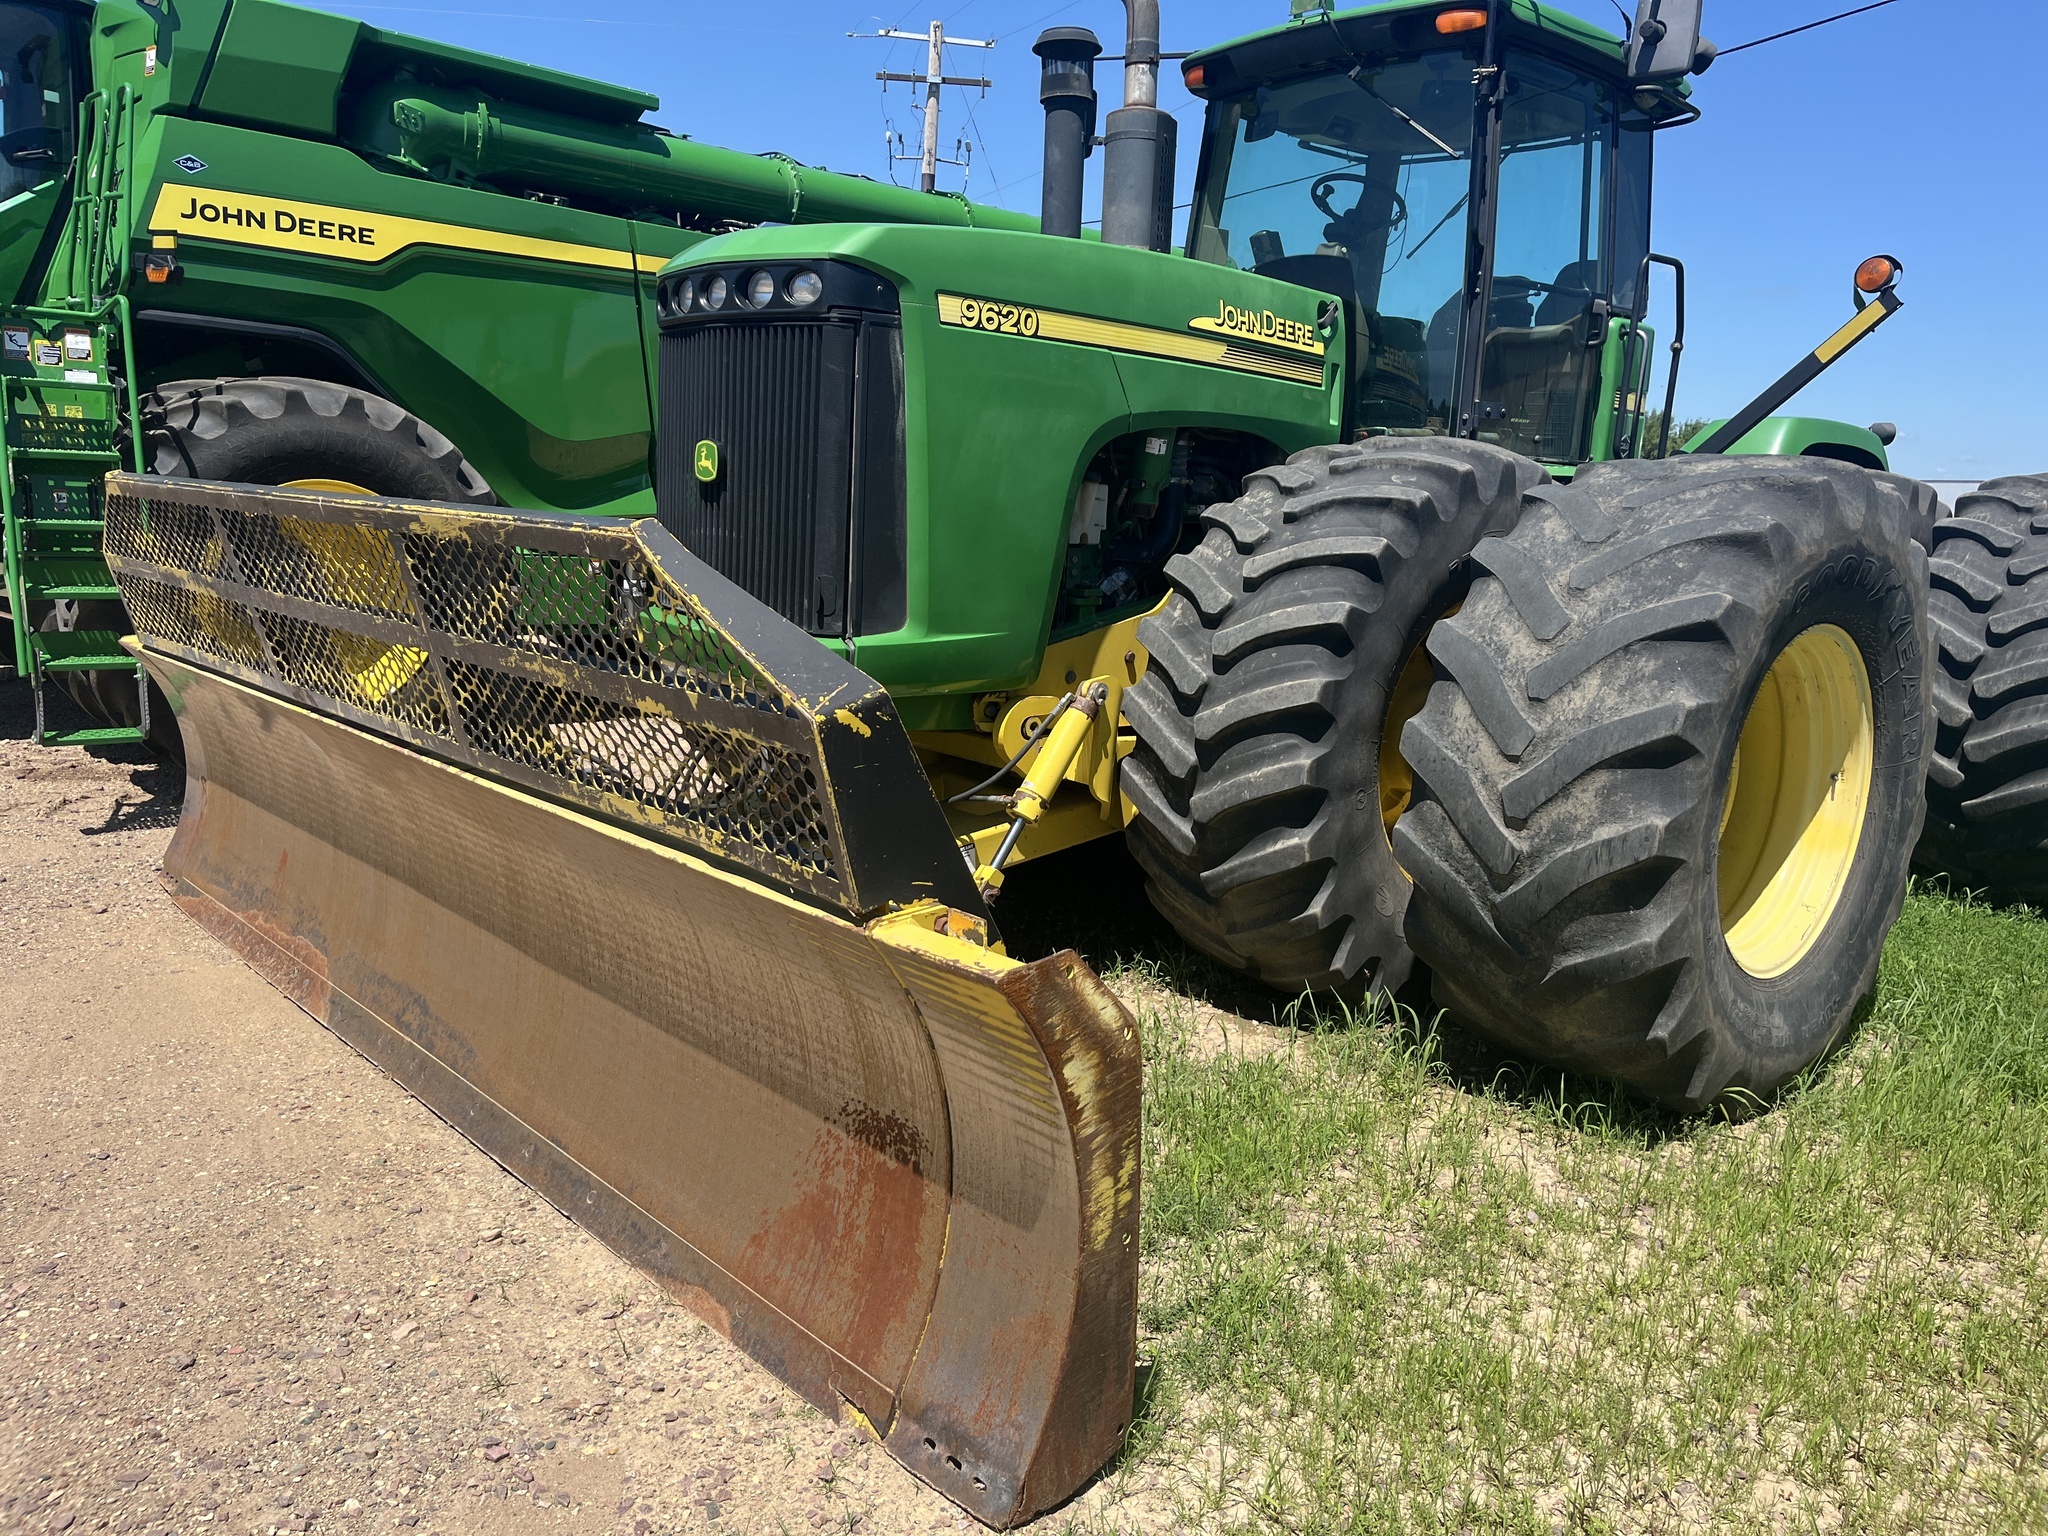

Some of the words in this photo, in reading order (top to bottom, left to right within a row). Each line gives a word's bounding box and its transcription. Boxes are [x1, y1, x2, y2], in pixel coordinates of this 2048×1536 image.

[179, 158, 202, 168] C&B
[180, 198, 266, 230] JOHN
[275, 210, 375, 246] DEERE
[960, 297, 1039, 337] 9620
[1214, 299, 1261, 335] JOHN
[1262, 309, 1314, 347] DEERE
